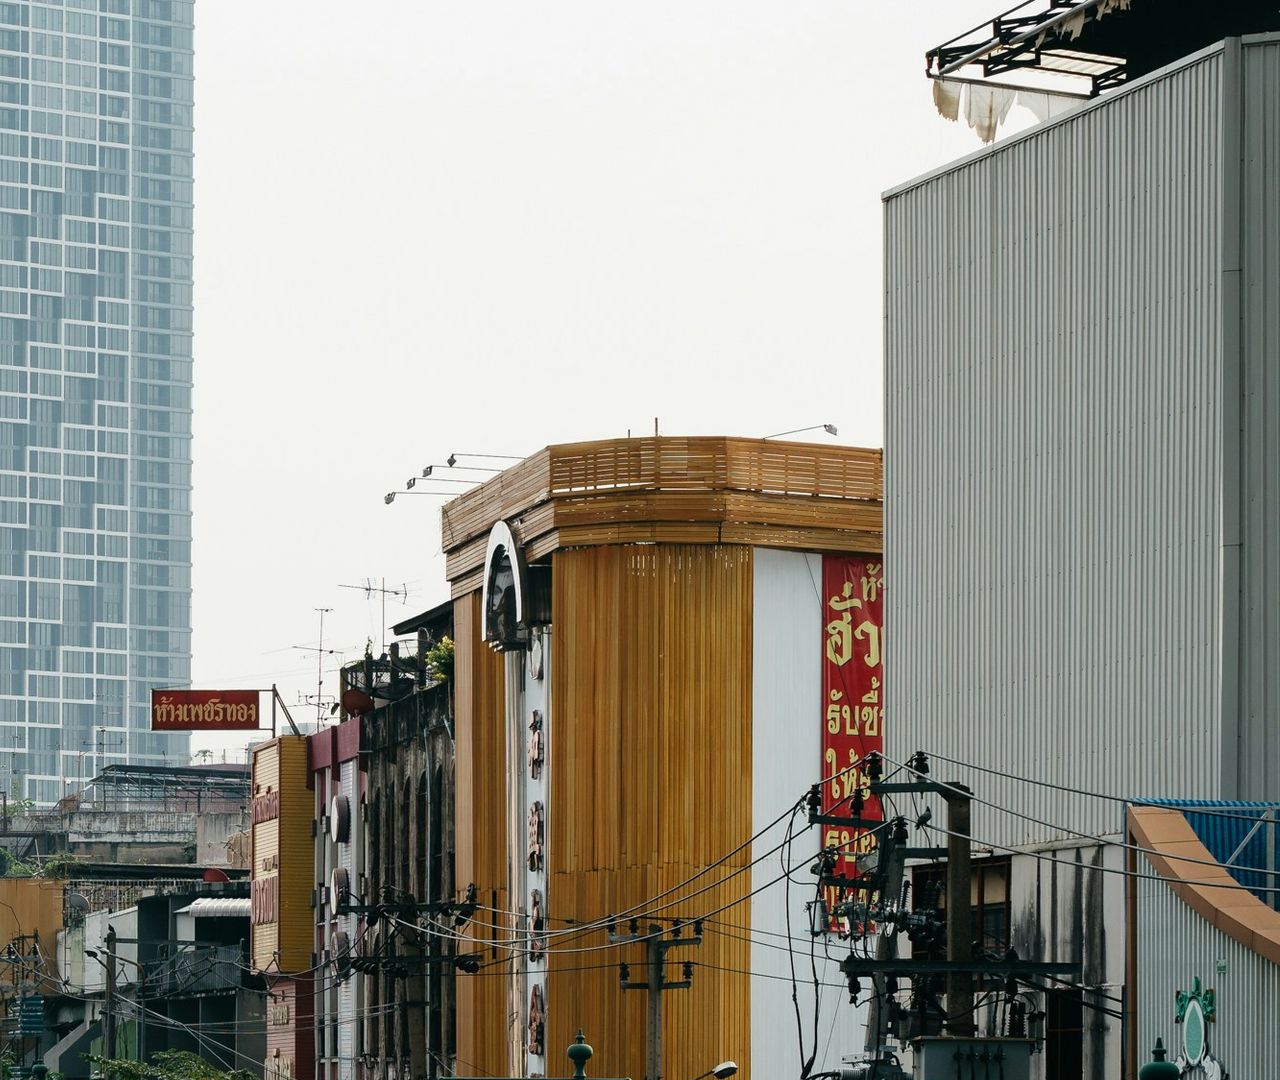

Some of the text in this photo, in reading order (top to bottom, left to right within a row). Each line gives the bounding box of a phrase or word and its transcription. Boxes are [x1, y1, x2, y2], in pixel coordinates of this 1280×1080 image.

[154, 695, 257, 722] ห้างเพชรทอง
